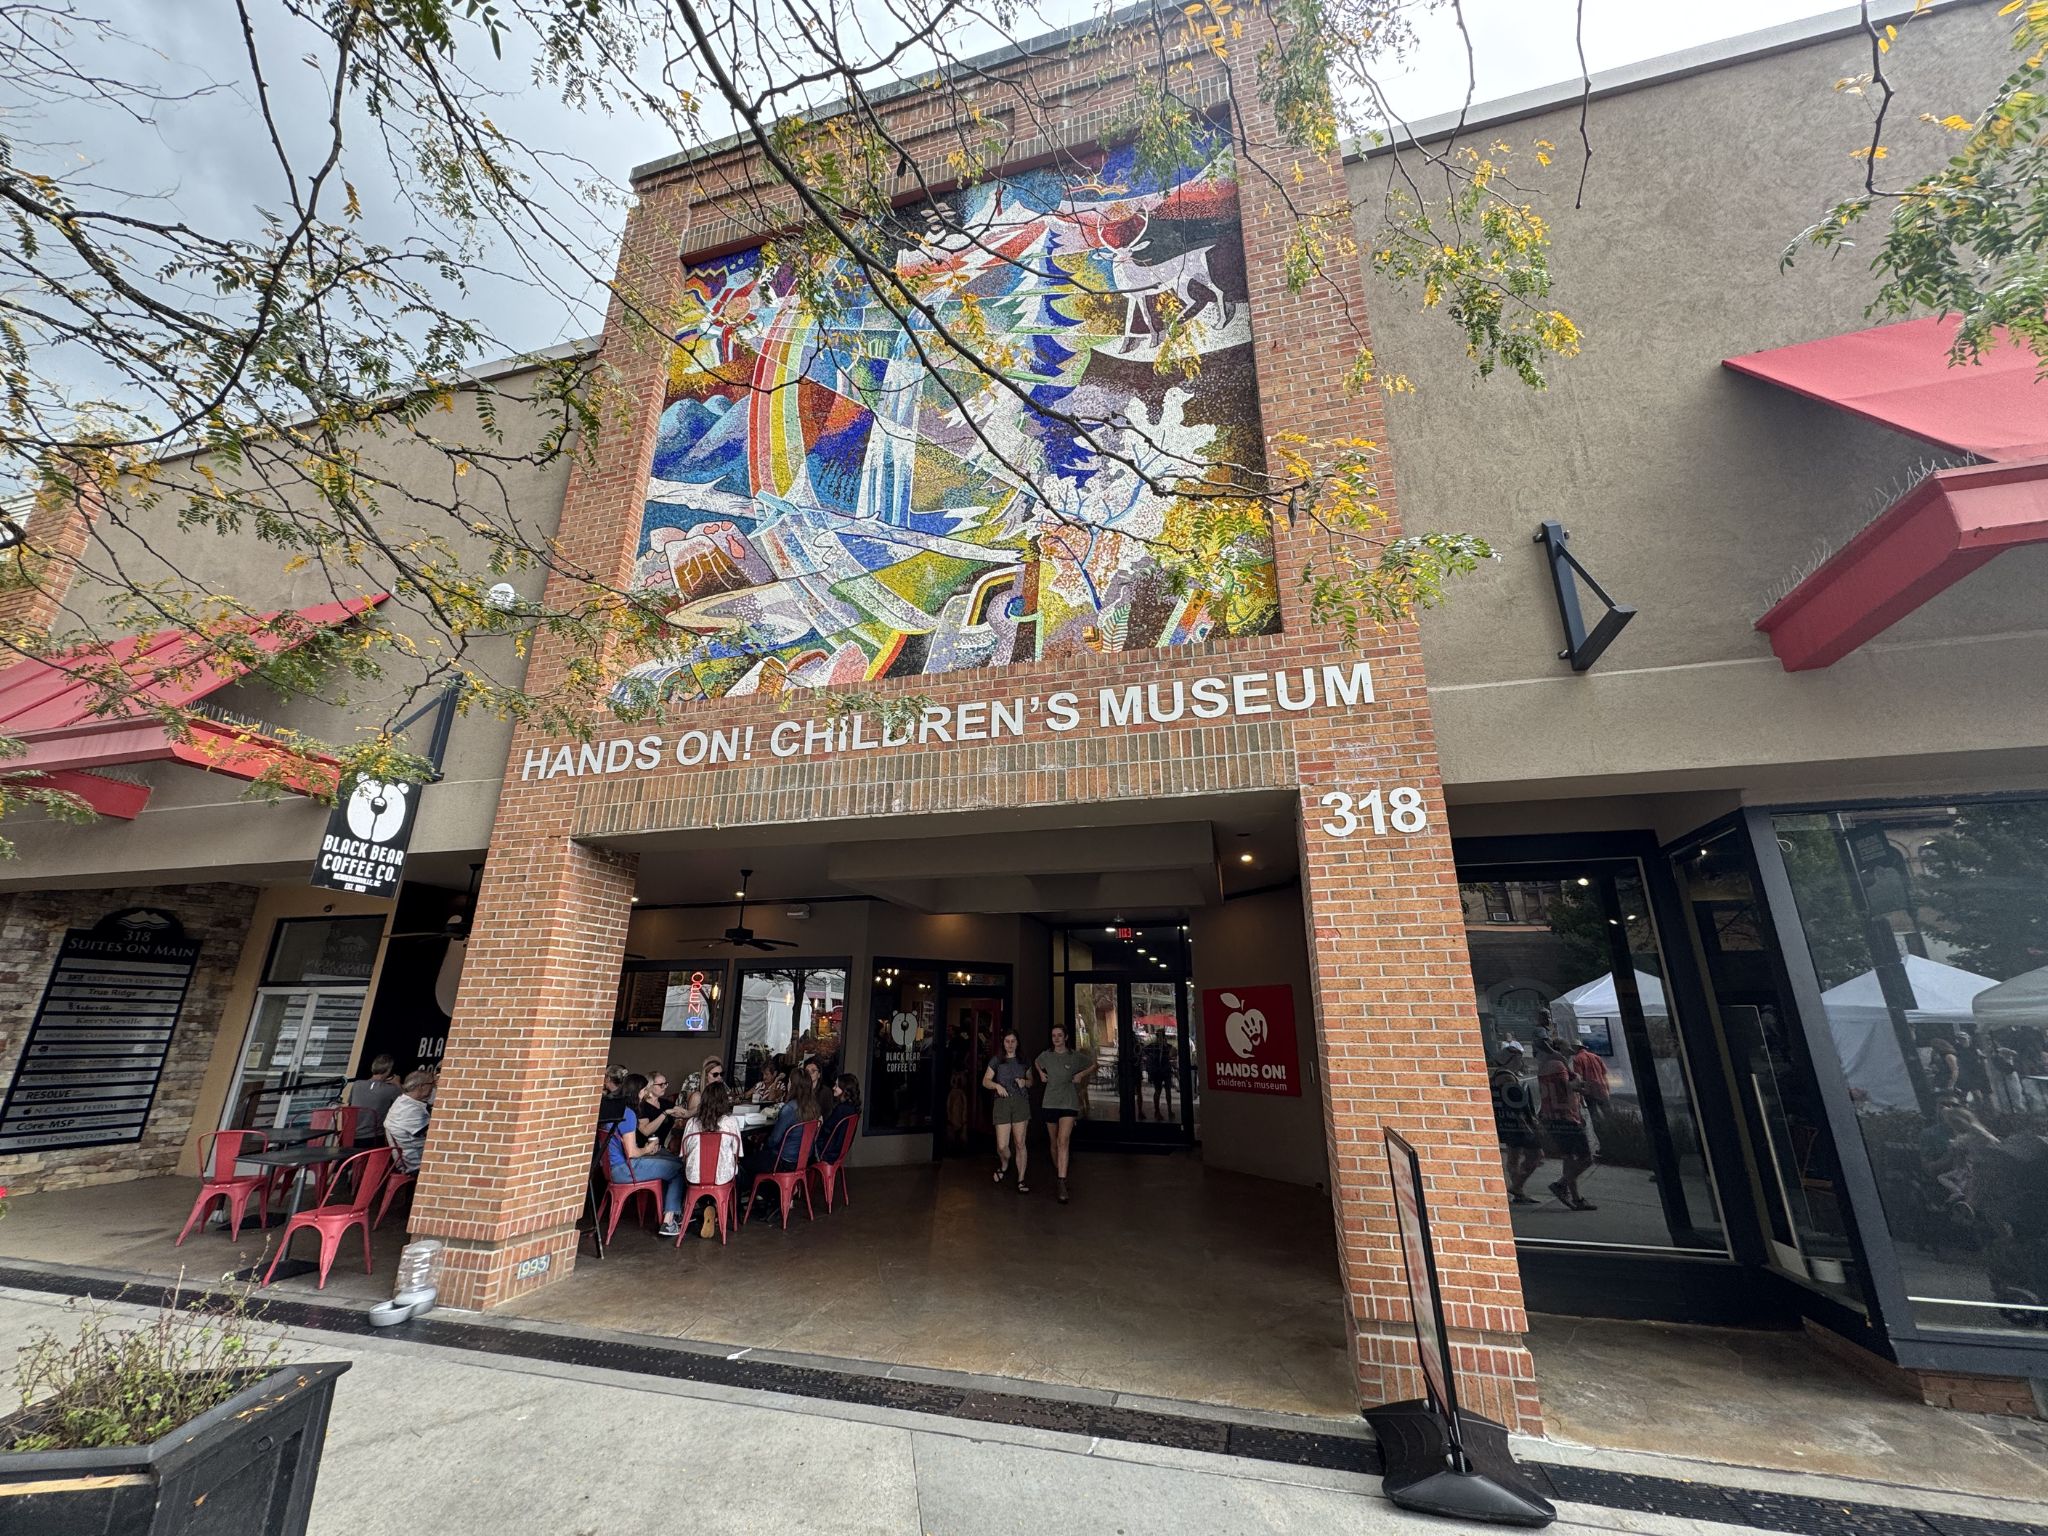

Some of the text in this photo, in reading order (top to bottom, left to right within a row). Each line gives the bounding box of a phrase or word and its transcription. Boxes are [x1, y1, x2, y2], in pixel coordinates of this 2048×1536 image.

[521, 662, 1375, 781] HANDS ON! CHILDREN'S MUSEUM
[1320, 786, 1427, 838] 318
[322, 834, 405, 866] BLACK BEAR
[321, 853, 375, 878] COFFEE
[375, 864, 397, 882] CO.
[123, 929, 151, 942] 318
[67, 937, 195, 958] SUITES ON MAIN
[88, 988, 137, 998] True Ridge
[688, 971, 704, 1013] OPEN
[417, 1036, 444, 1058] BLA
[886, 1051, 921, 1061] BLACK BEAR
[887, 1063, 908, 1072] COFFEE
[1216, 1062, 1287, 1080] HANDS ON!
[1217, 1078, 1288, 1091] children's museum
[25, 1089, 72, 1100] RESOLVE
[16, 1118, 76, 1131] Core-MSP
[516, 1255, 547, 1280] 1993
